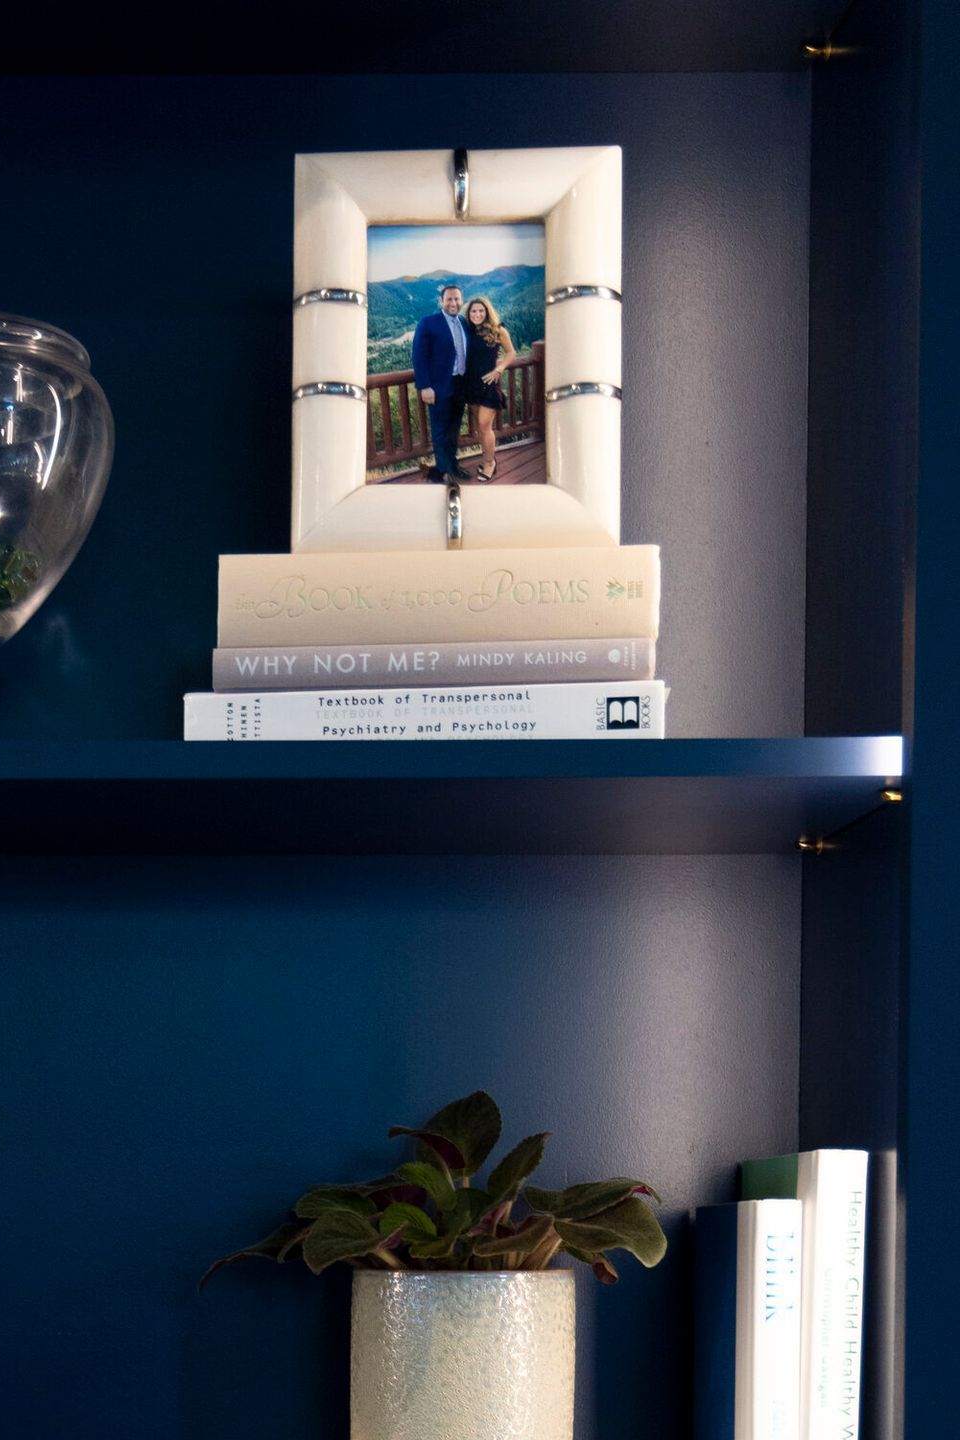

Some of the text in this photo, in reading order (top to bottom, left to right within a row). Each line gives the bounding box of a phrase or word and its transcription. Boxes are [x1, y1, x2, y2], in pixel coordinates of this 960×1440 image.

[234, 650, 588, 676] WHY NOT ME? MINDY KALING
[318, 690, 531, 707] Textbook of Transpersonal
[595, 697, 606, 731] BASIC
[641, 695, 651, 729] BOOKS
[322, 720, 537, 736] Psychiatry and Psychology
[846, 1191, 863, 1267] Healthy
[844, 1277, 860, 1329] Child
[839, 1340, 857, 1416] Healthy
